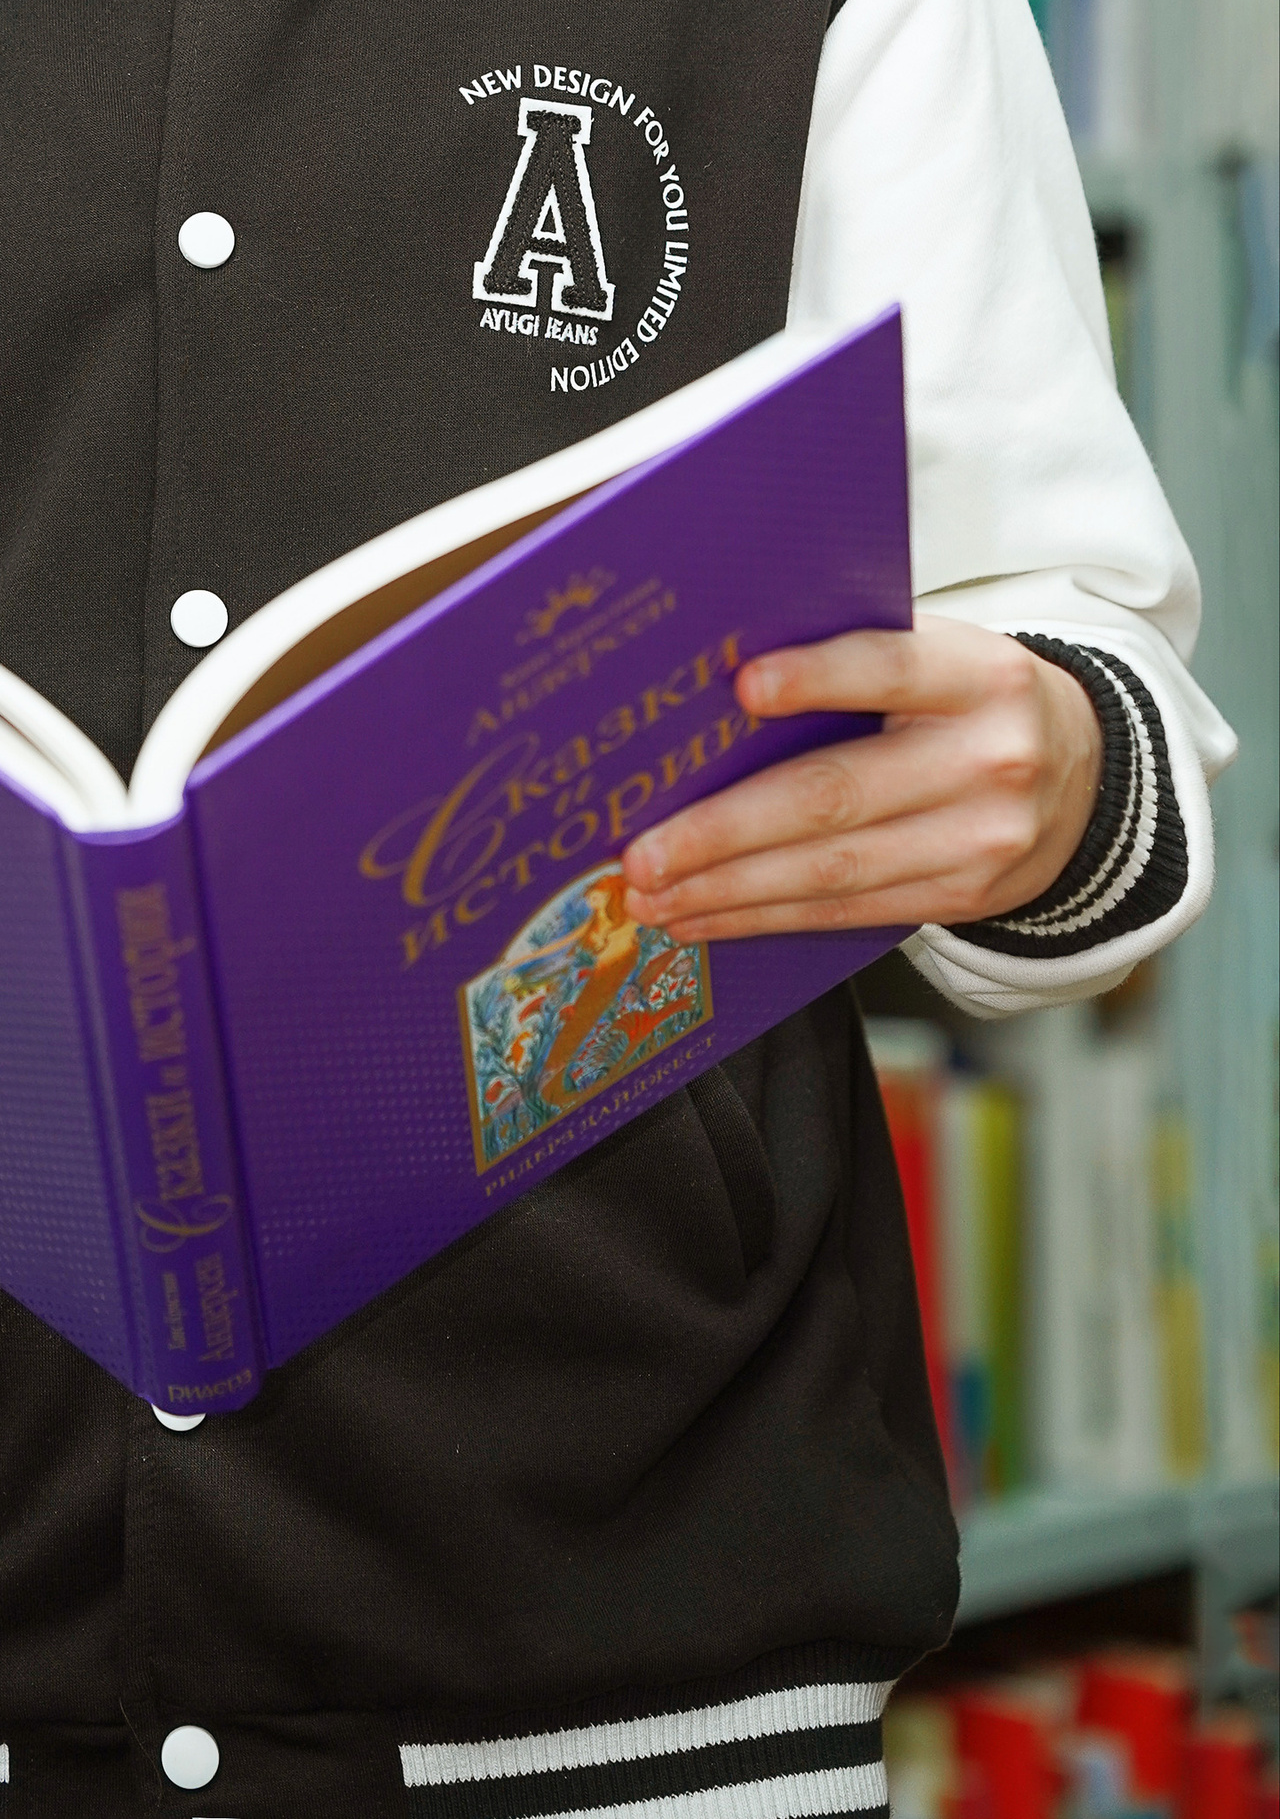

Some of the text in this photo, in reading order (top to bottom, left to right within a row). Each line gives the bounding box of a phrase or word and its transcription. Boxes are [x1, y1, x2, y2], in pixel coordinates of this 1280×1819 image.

[459, 64, 689, 393] NEW DESIGN FOR YOU LIMITED EDITION
[472, 97, 616, 321] A
[479, 308, 599, 346] AYUGI JEANS
[358, 628, 744, 907] Сказки
